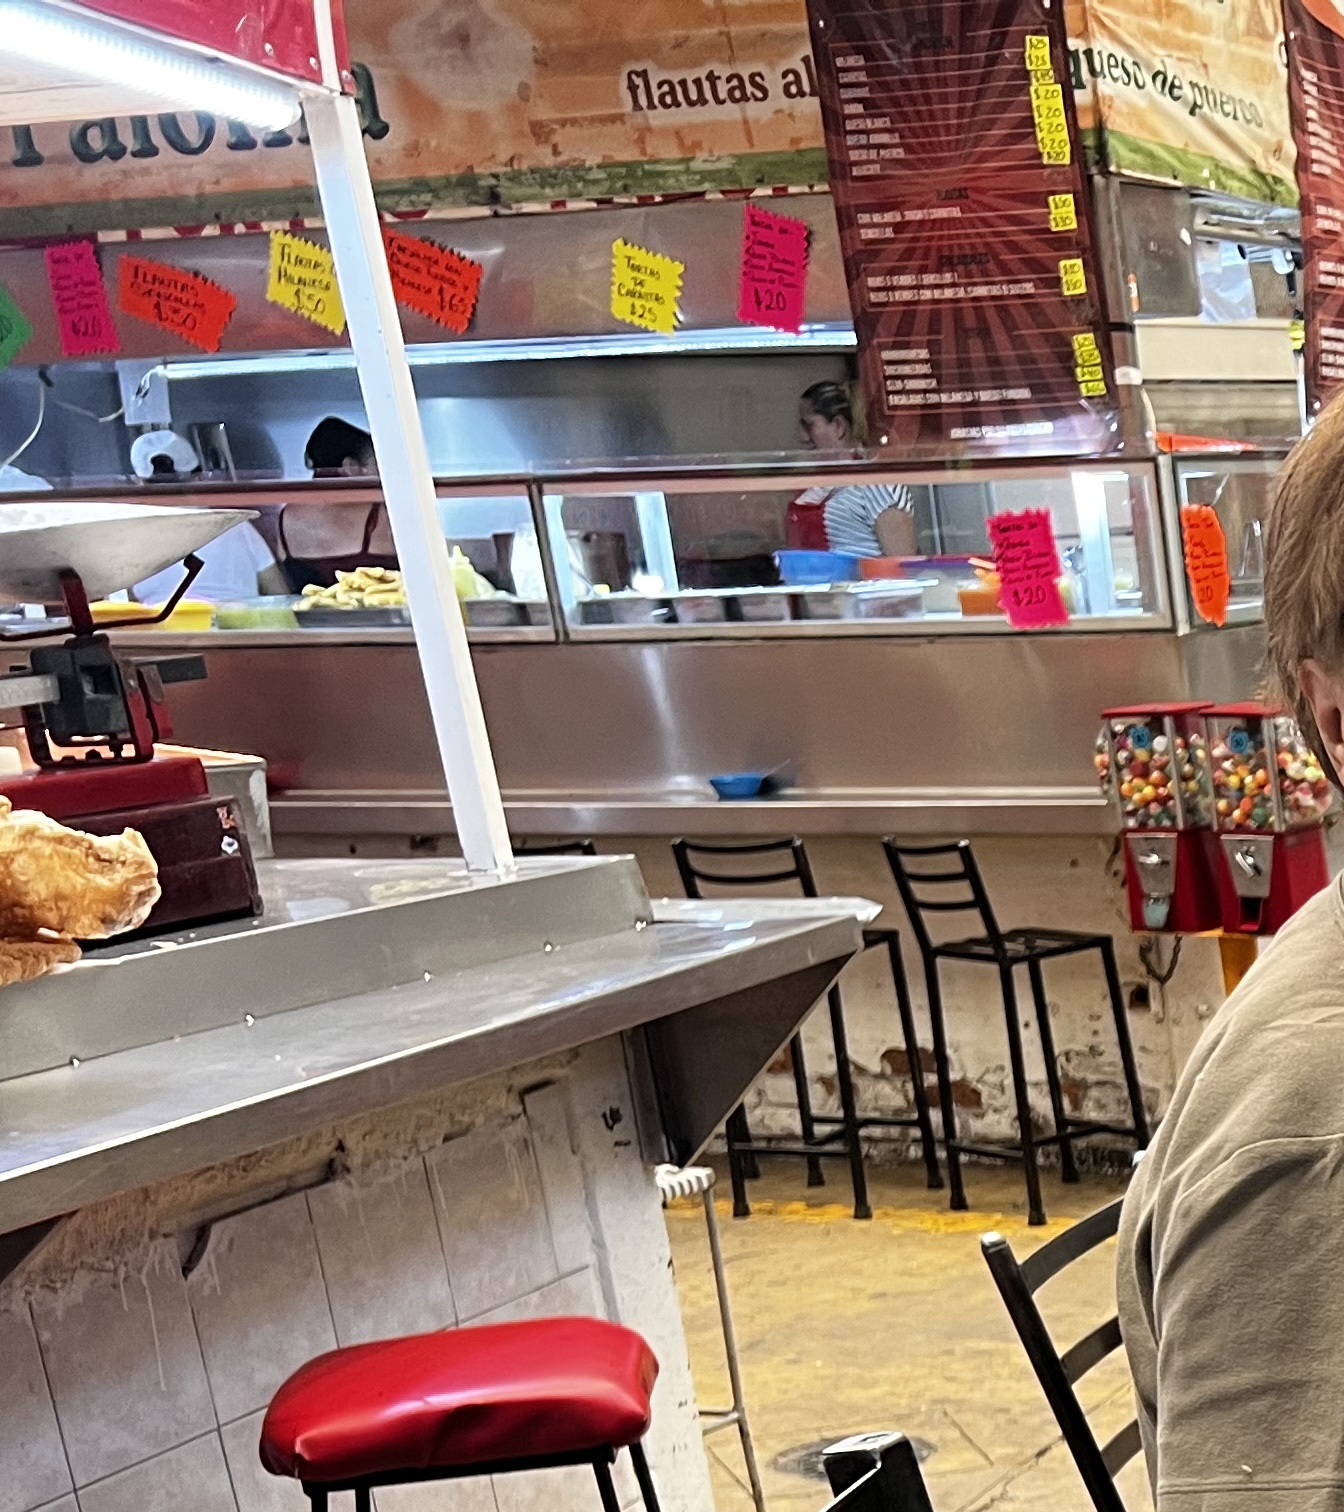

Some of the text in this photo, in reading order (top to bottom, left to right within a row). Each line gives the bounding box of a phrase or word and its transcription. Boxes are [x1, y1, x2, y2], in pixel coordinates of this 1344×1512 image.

[627, 67, 769, 112] flautas
[1151, 60, 1183, 102] de
[1189, 80, 1264, 128] puerco
